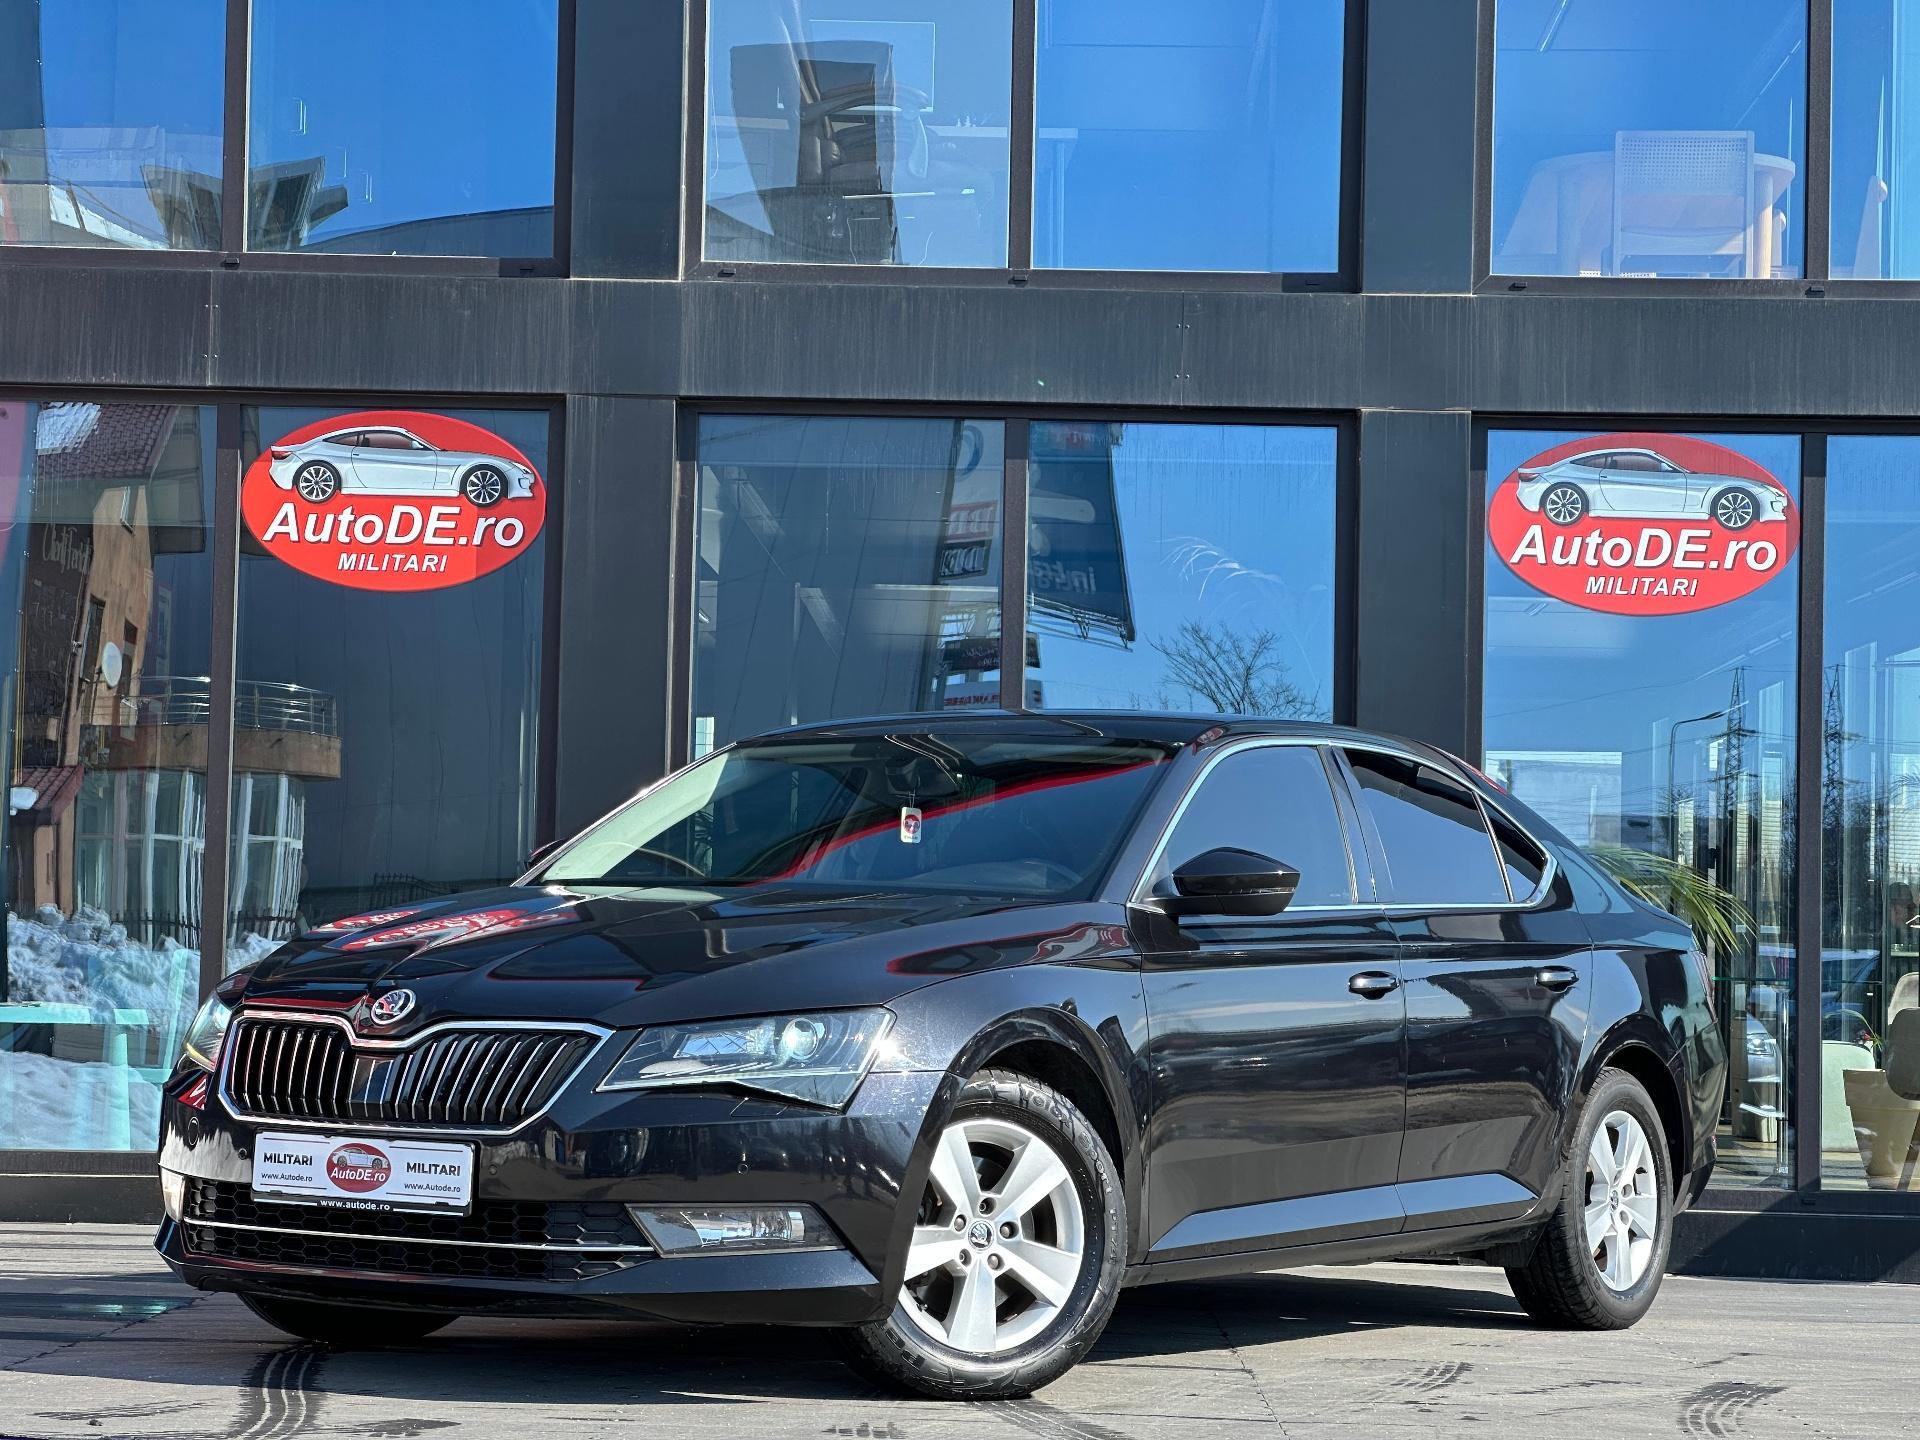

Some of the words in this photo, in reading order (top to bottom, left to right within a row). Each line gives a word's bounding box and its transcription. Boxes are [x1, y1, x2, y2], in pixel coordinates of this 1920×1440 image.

[262, 502, 525, 548] AutoDE.ro
[1509, 524, 1778, 571] AutoDE.ro
[338, 552, 448, 573] MILITARI
[1584, 576, 1699, 597] MILITARI
[263, 1152, 313, 1166] MILITARI
[260, 1172, 313, 1182] www.Autode.ro
[330, 1167, 387, 1182] AutoDE.ro
[406, 1162, 461, 1177] MILITARI
[403, 1182, 461, 1193] www.Autode.ro
[319, 1199, 391, 1211] www.autode.ro
